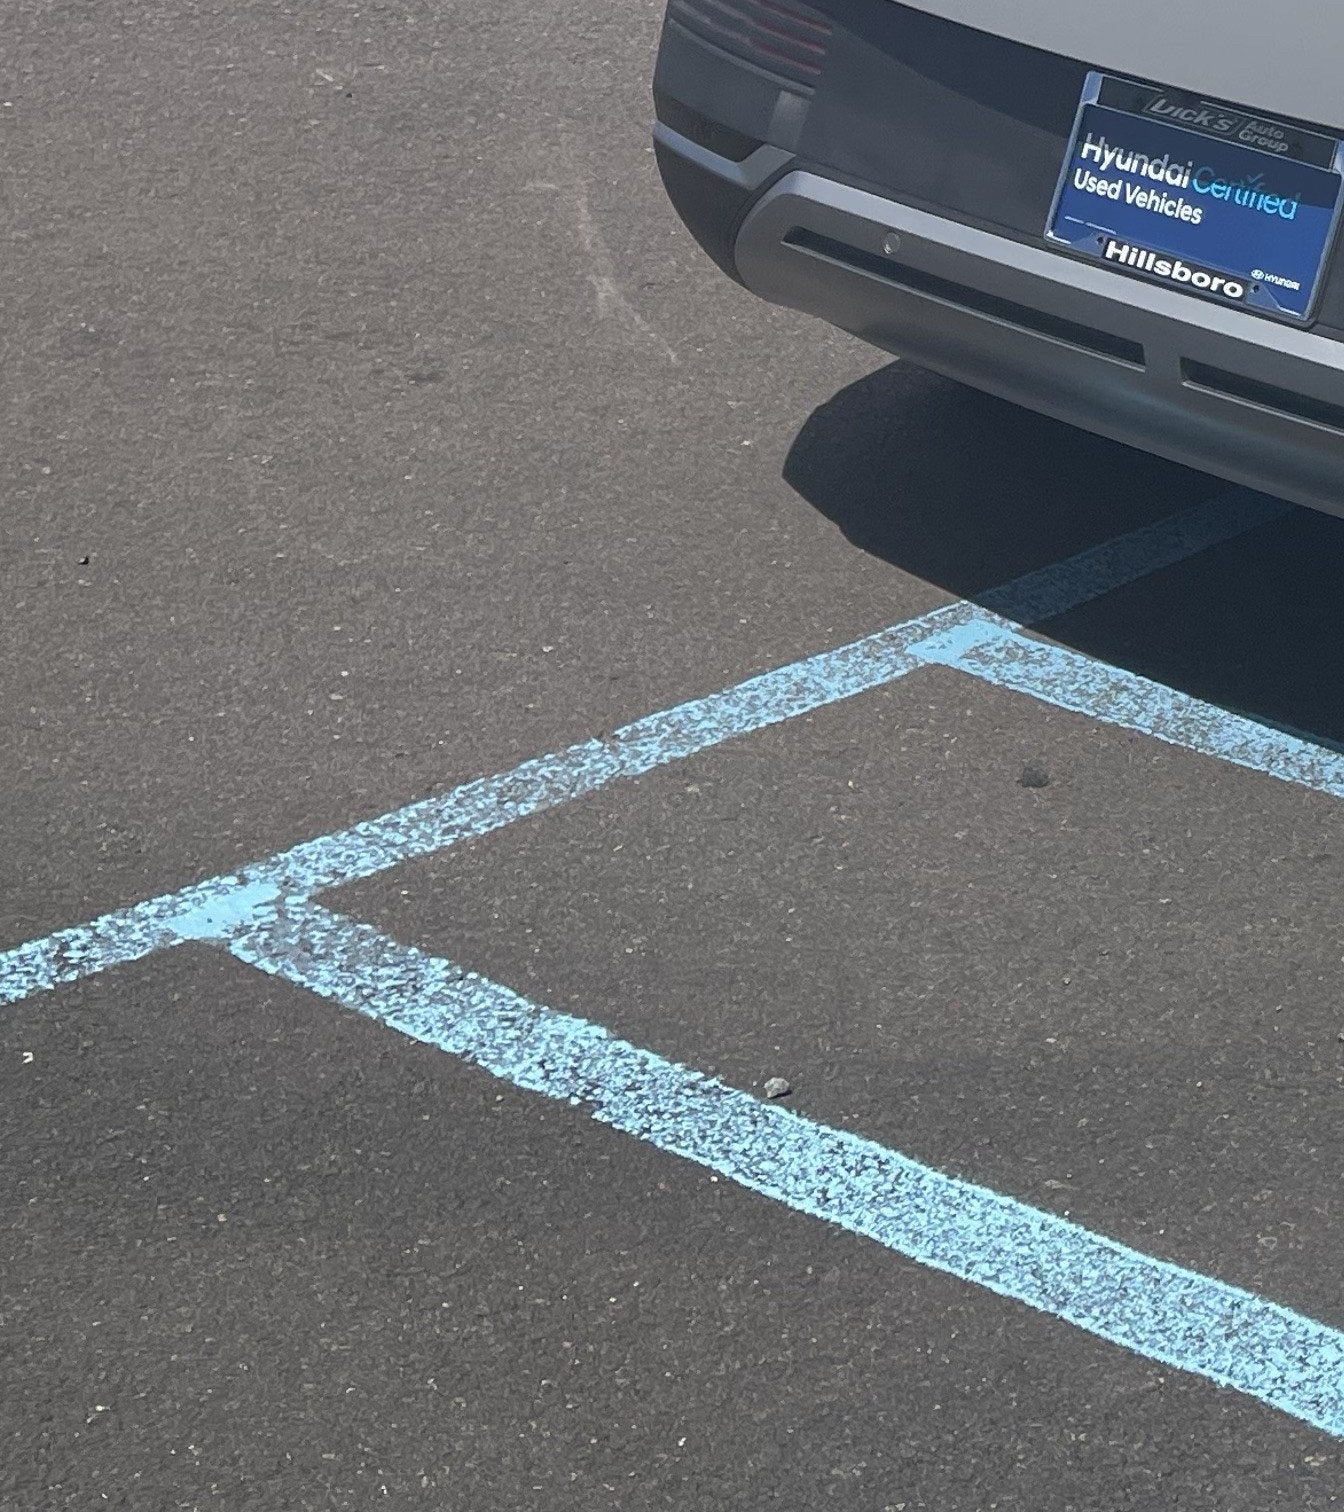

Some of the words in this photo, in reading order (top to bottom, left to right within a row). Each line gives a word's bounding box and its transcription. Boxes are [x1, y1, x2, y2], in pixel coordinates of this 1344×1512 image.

[1238, 129, 1289, 153] Group
[1074, 167, 1123, 201] Used
[1125, 182, 1203, 225] Vehicles
[1081, 133, 1194, 189] Hyundai
[1192, 166, 1301, 220] Certified
[1105, 240, 1244, 299] Hillsboro
